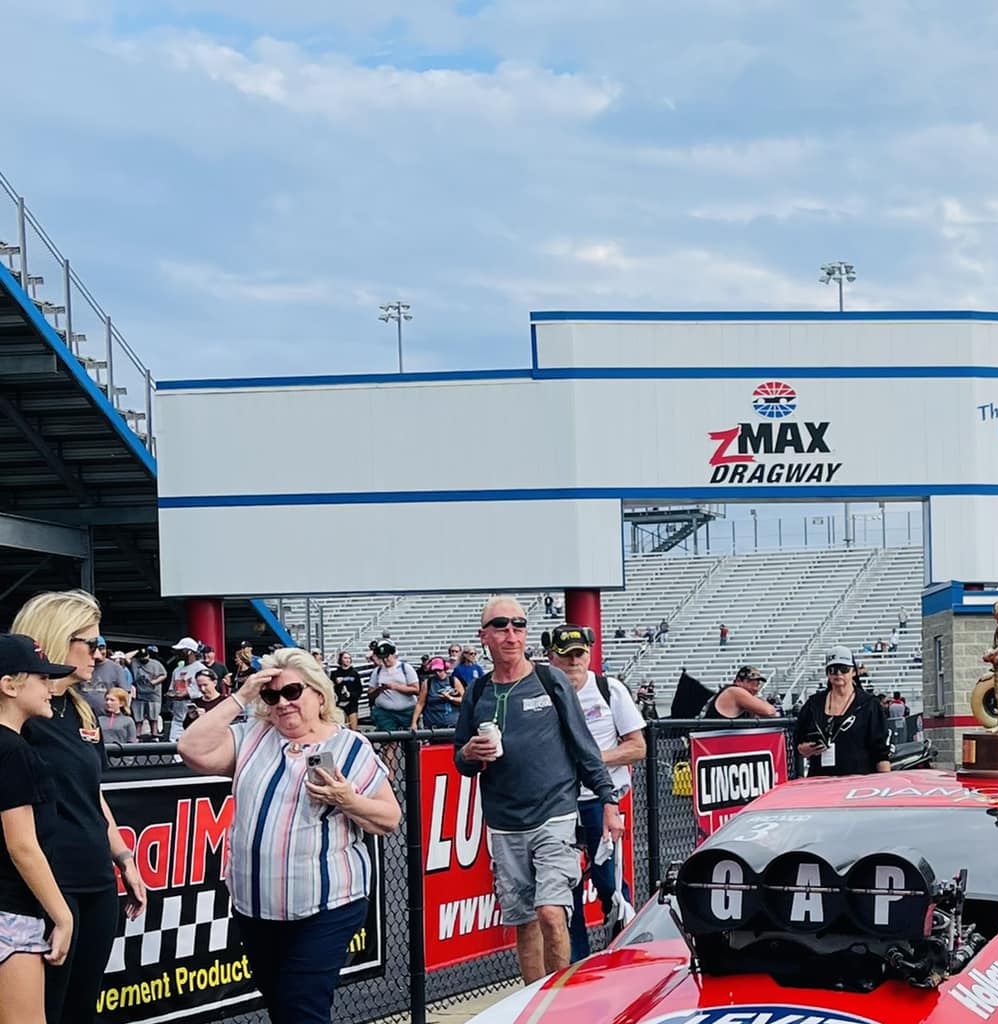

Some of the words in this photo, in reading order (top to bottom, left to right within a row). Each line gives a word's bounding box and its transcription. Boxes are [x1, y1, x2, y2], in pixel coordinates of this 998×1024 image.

[709, 463, 843, 484] DRAGWAY
[701, 761, 770, 805] LINCOLN
[425, 773, 493, 872] LU
[96, 972, 172, 1013] vement
[175, 954, 252, 995] Product
